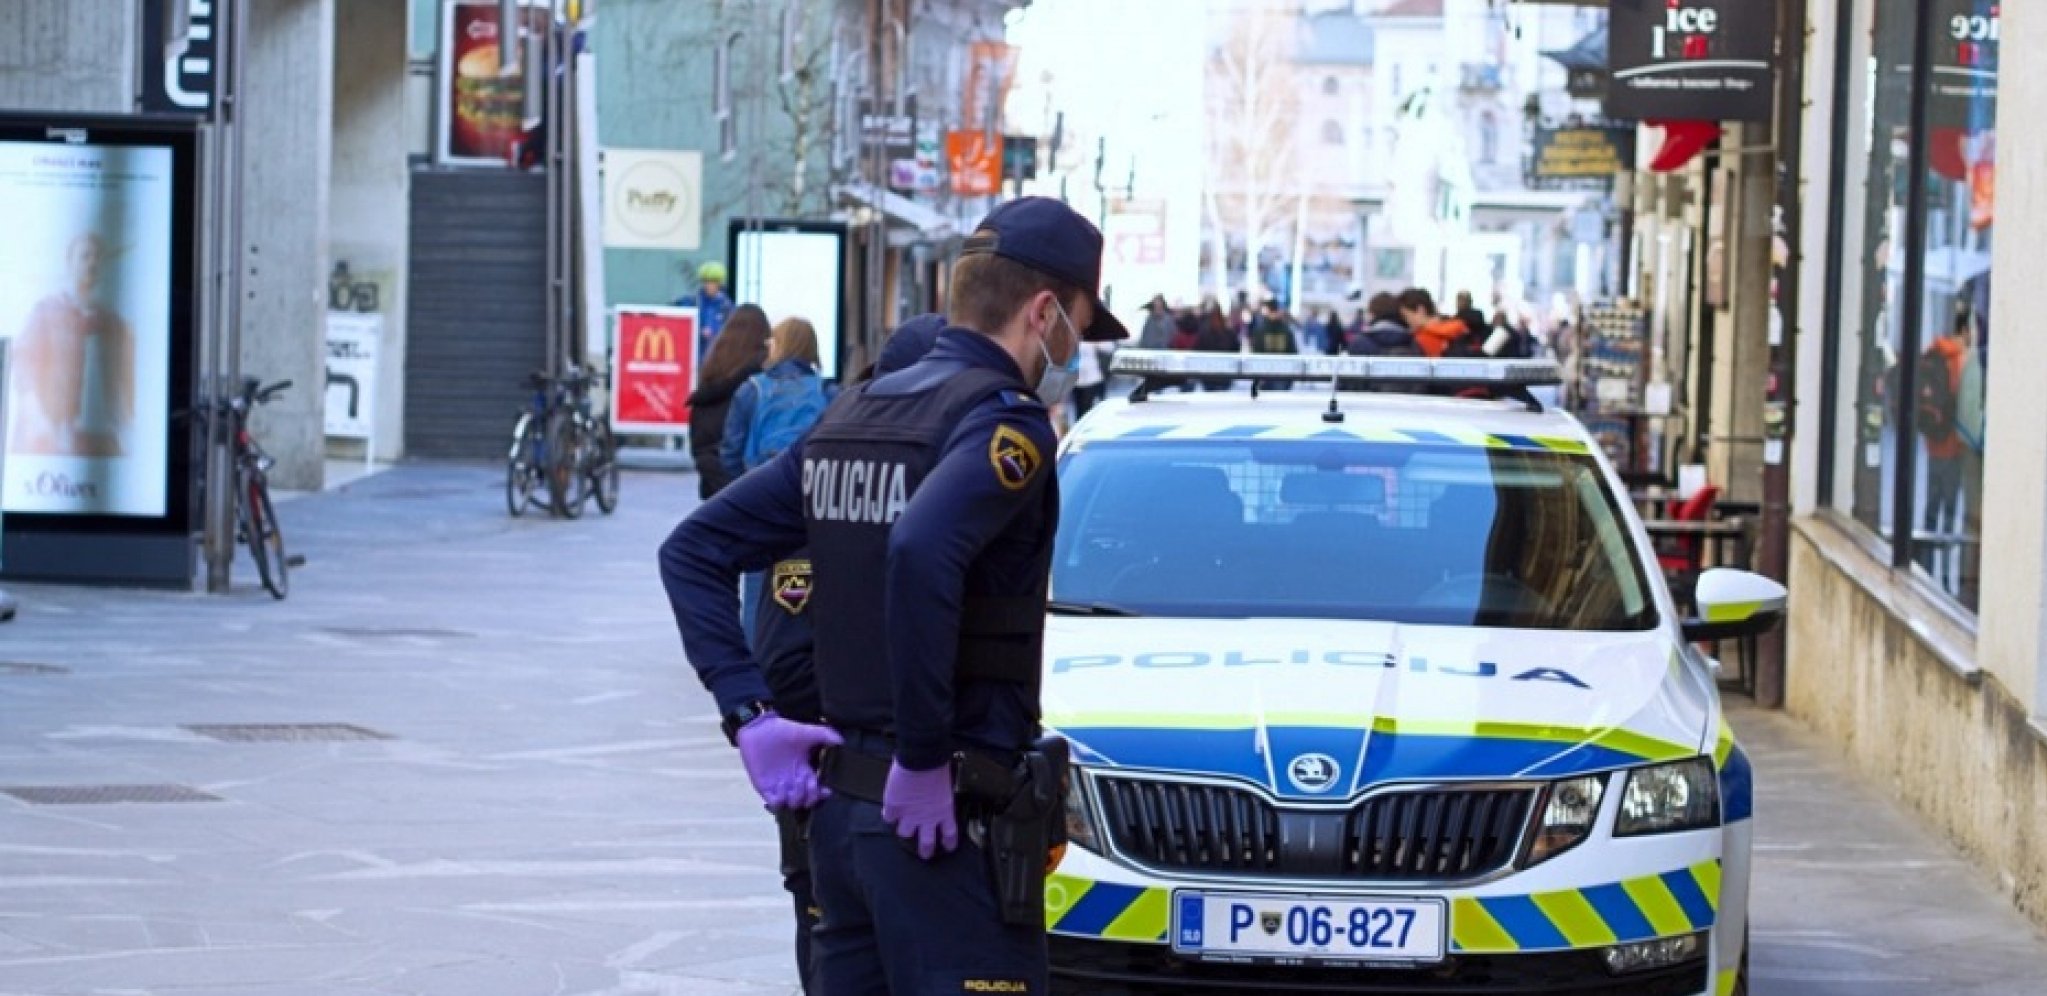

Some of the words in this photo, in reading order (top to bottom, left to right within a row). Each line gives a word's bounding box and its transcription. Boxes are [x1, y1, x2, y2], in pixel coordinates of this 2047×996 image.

[1666, 0, 1718, 33] ice
[627, 189, 677, 212] Puffy
[802, 457, 909, 525] POLICIJA
[1052, 650, 1593, 690] POLICIJA
[1230, 903, 1254, 943] P
[1287, 905, 1417, 948] 06-827
